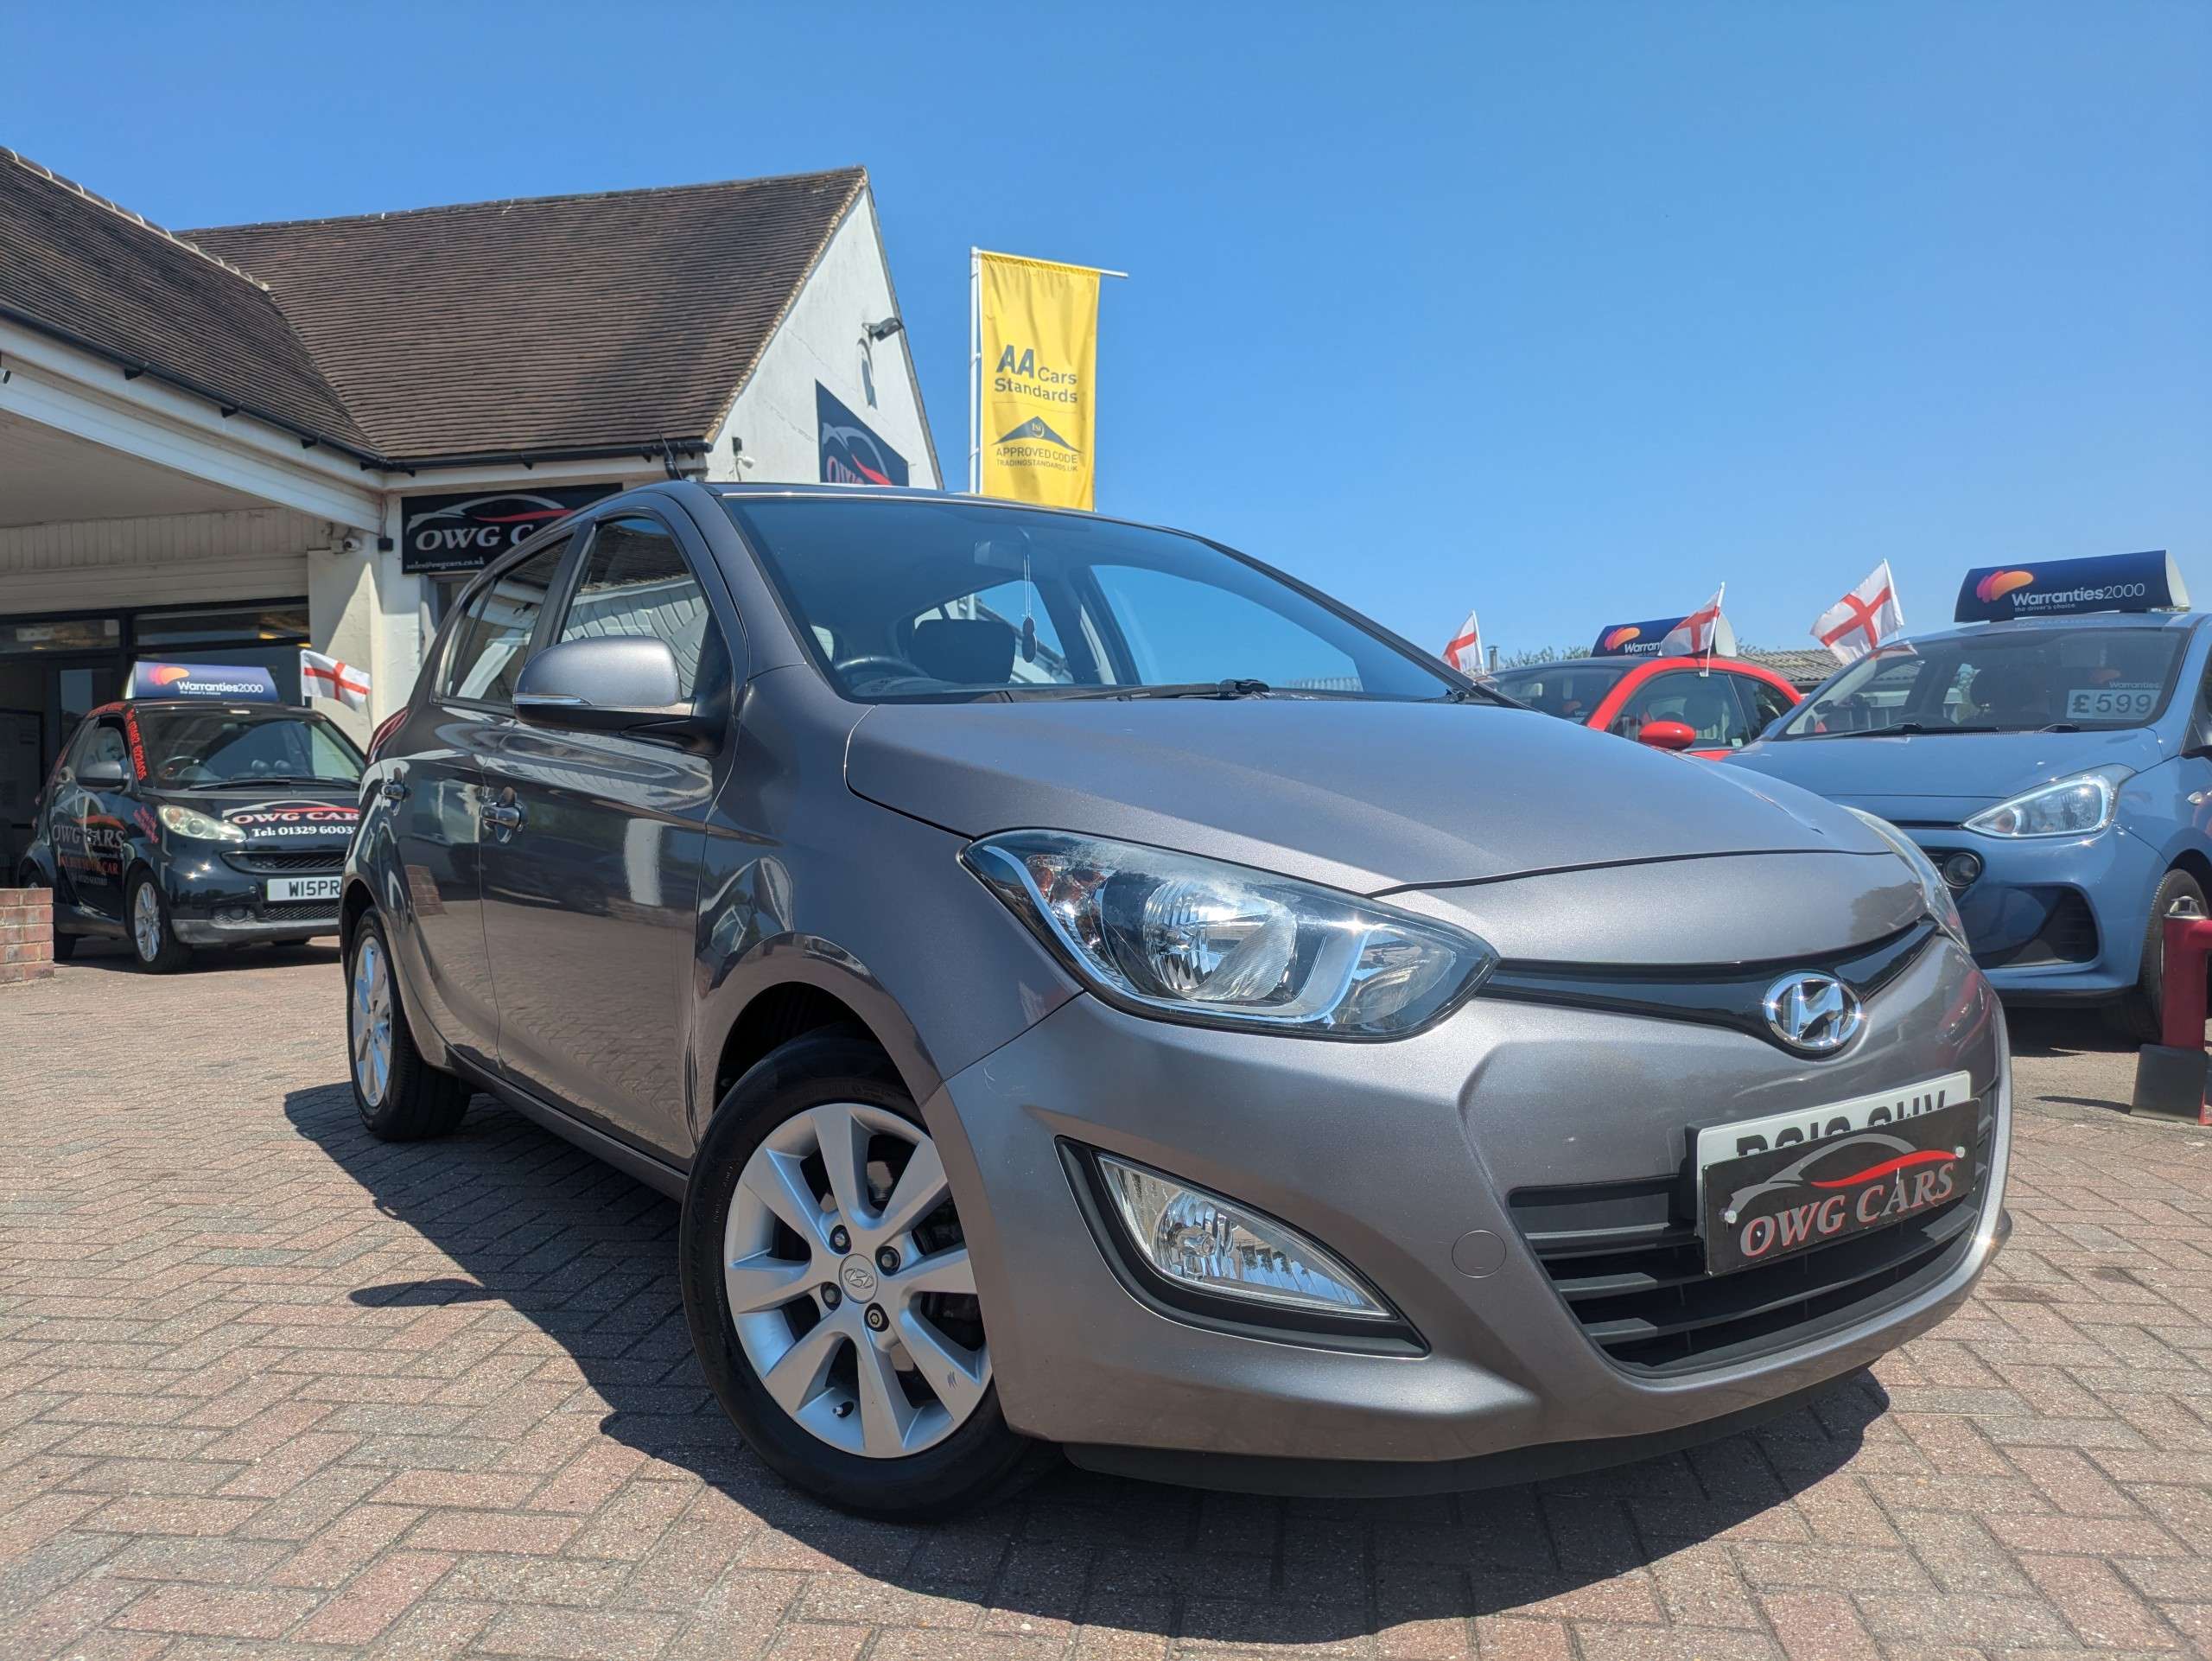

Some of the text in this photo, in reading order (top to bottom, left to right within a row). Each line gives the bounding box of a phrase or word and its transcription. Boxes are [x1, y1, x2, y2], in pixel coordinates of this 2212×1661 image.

[995, 345, 1077, 385] AA Cars
[995, 378, 1078, 403] Standards
[996, 447, 1077, 463] APPROVED CODE
[416, 525, 501, 550] OWG
[2012, 583, 2145, 606] Warranties2000
[1624, 642, 1661, 653] Warran
[177, 681, 264, 693] Warranties2000
[2108, 681, 2159, 690] Warranties
[232, 811, 359, 824] OWG CAR
[52, 824, 80, 844] OWG
[251, 827, 276, 837] Tel:
[278, 826, 317, 836] 01329
[289, 881, 340, 897] W15PR
[1740, 1161, 1955, 1257] OWG CARS
